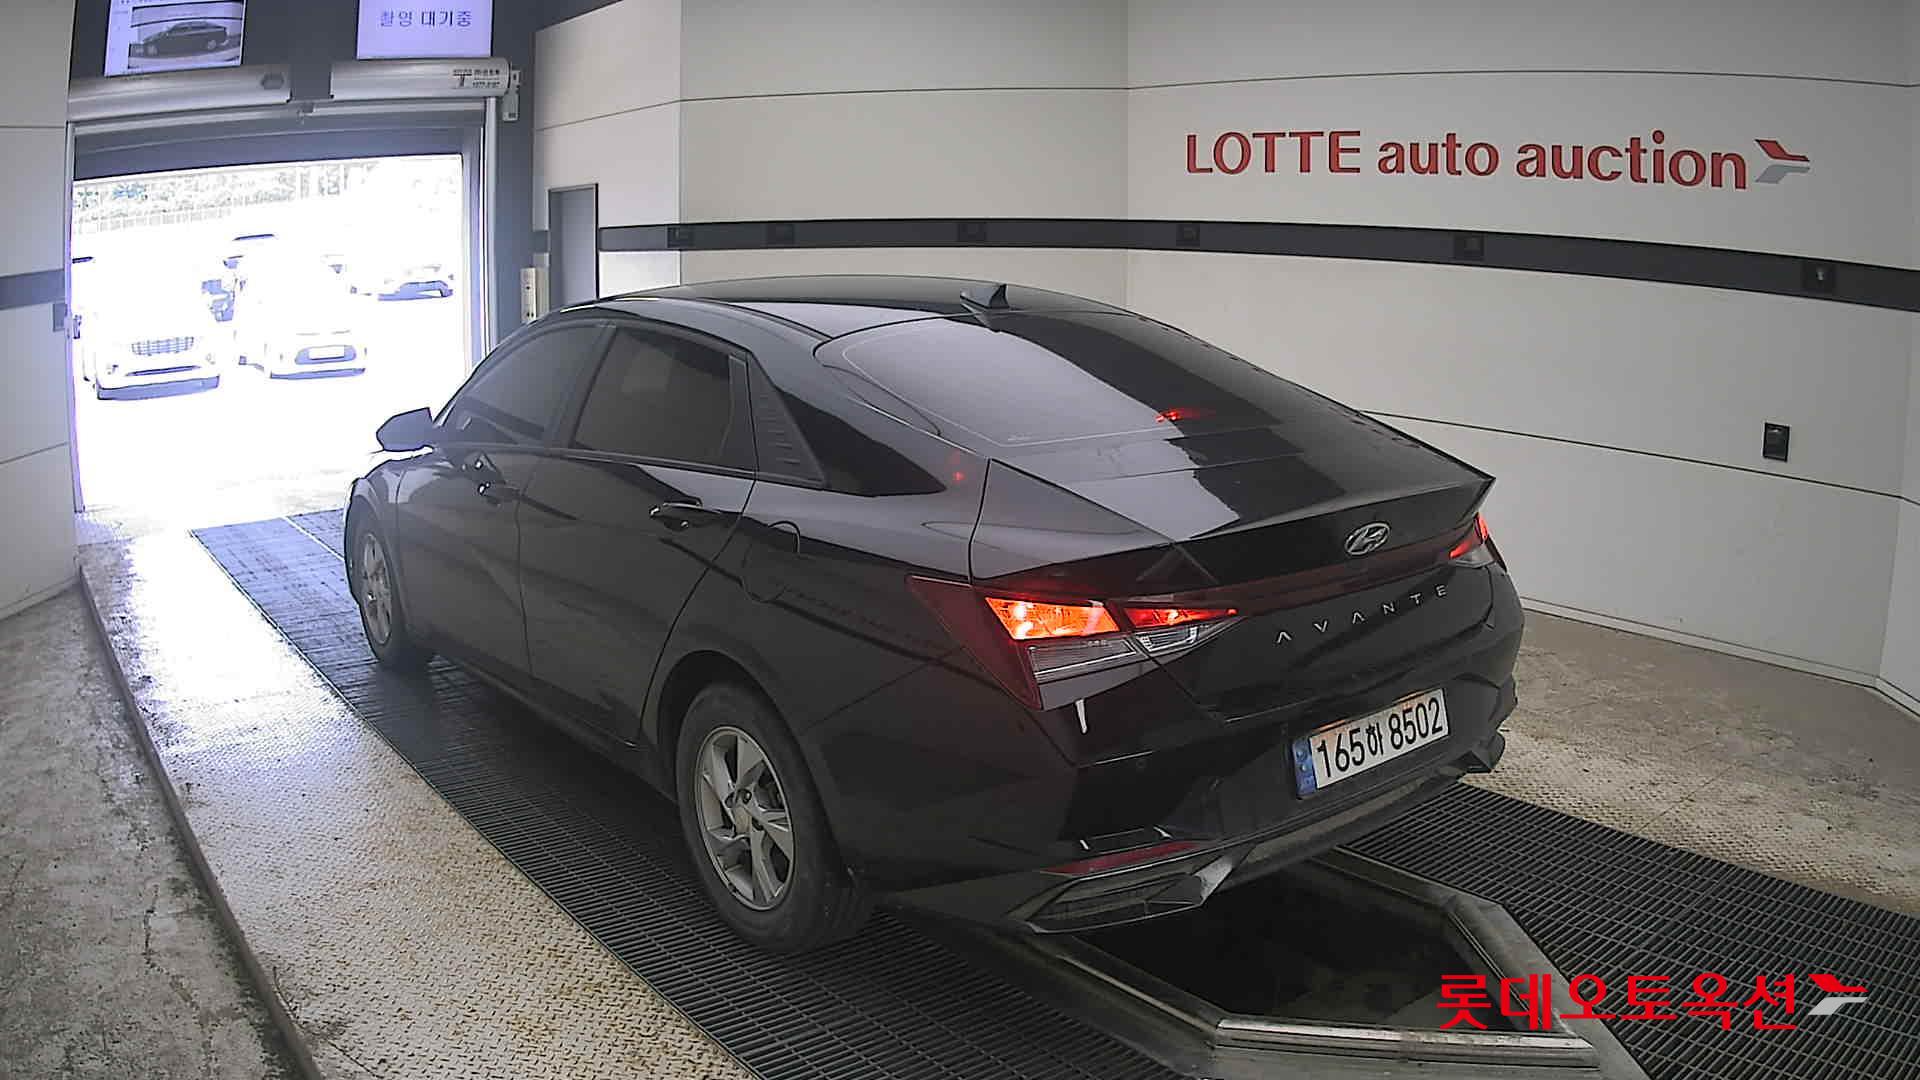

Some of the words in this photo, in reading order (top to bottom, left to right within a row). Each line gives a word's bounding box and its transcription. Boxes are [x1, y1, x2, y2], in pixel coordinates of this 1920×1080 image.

[421, 10, 473, 28] 대기중
[1186, 130, 1360, 175] LOTTE
[1378, 133, 1500, 177] auto
[1516, 130, 1748, 190] auction
[1275, 584, 1448, 645] AVANTE
[1317, 722, 1384, 778] 165하
[1388, 697, 1443, 750] 8502
